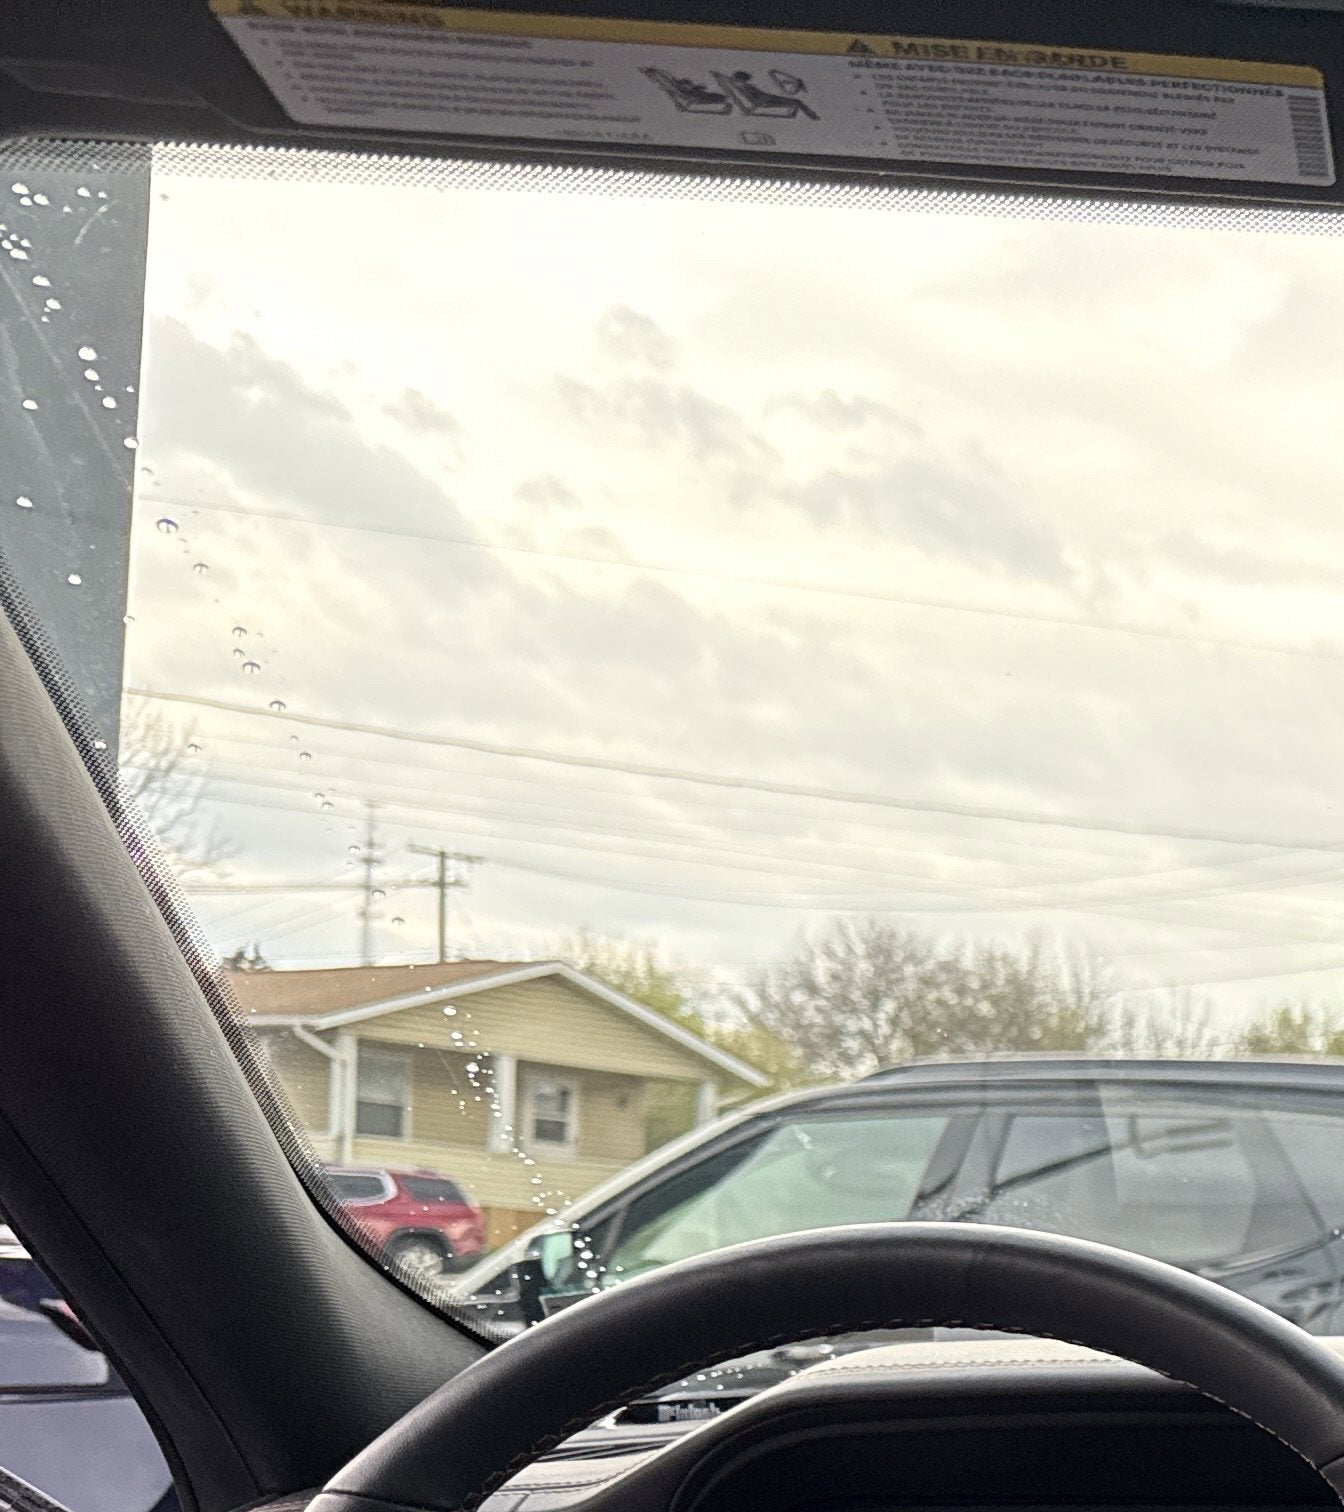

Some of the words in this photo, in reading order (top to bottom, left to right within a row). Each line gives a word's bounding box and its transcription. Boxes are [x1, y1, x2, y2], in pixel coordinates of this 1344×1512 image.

[891, 40, 970, 61] MISE
[976, 46, 1024, 65] EN
[1027, 49, 1130, 70] GARDE
